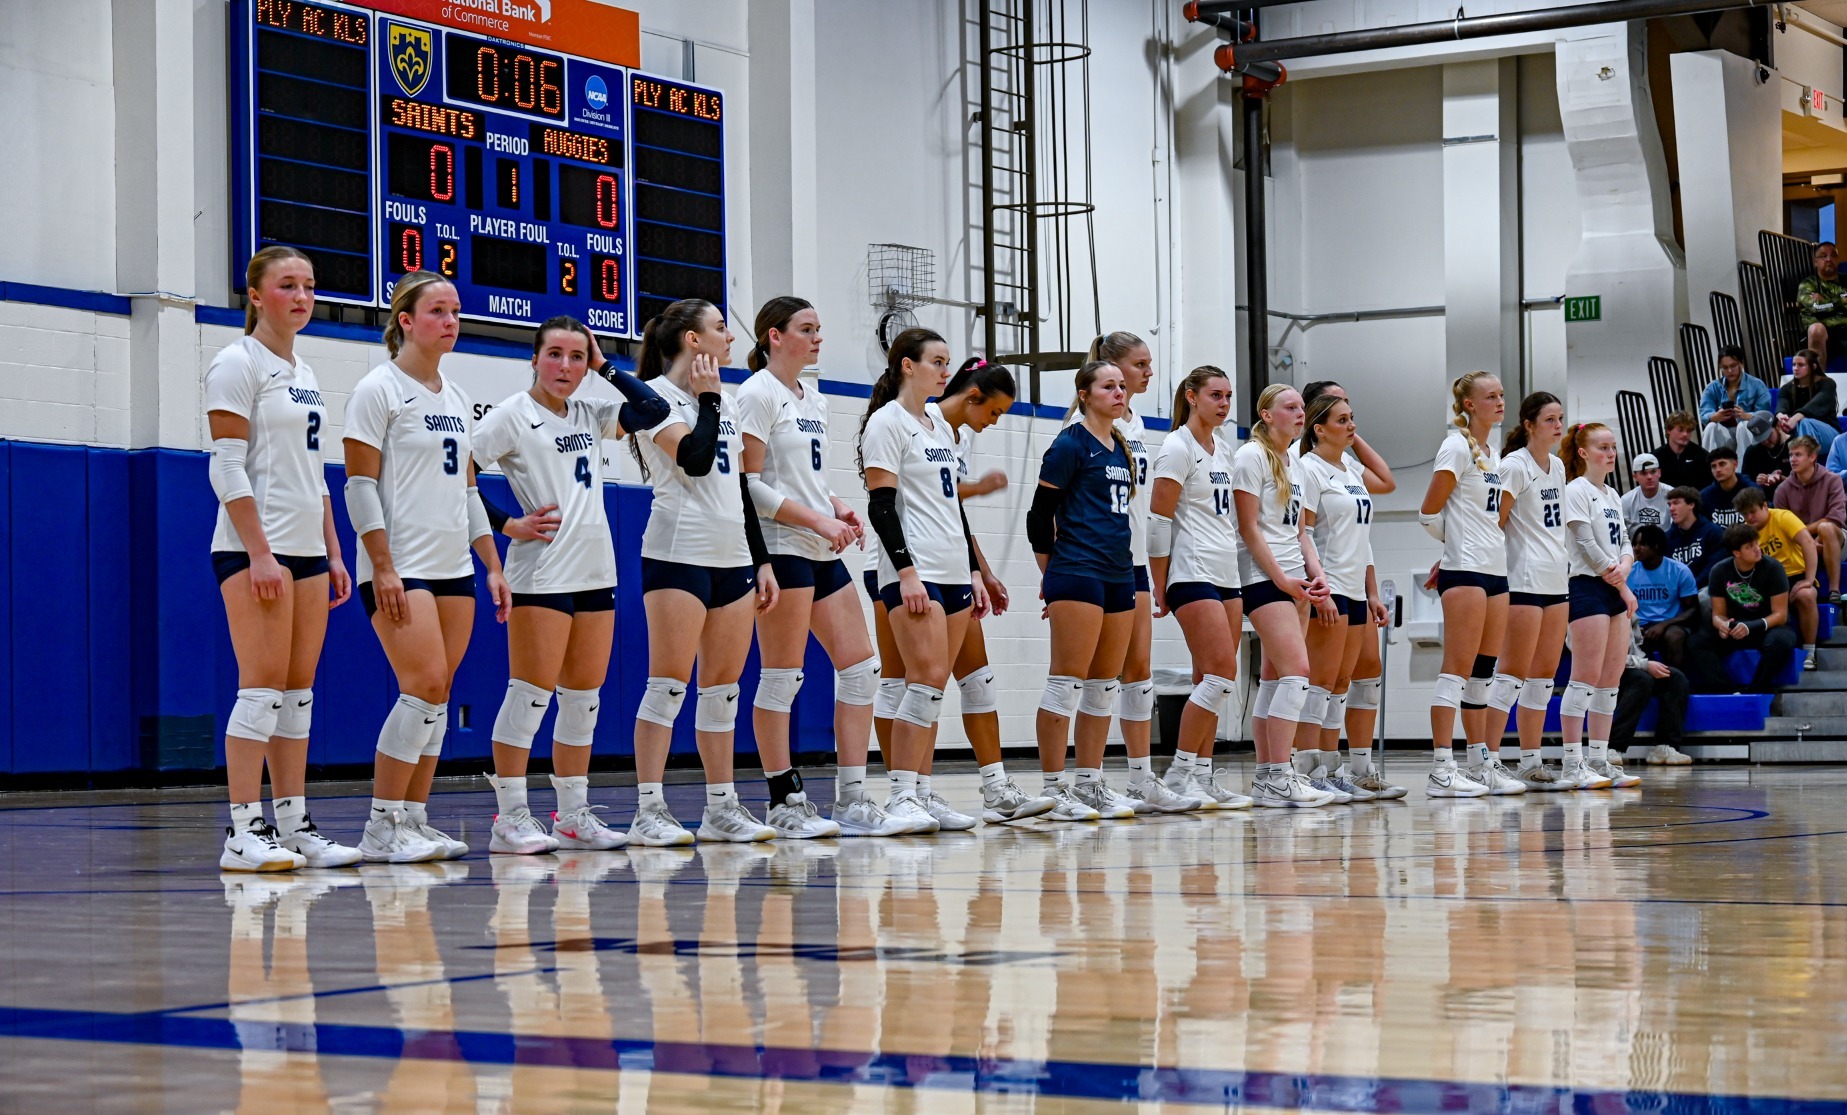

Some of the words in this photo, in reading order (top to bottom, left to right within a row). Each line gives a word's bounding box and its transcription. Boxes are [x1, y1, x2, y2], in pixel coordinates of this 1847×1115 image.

[258, 0, 291, 27] PLY
[303, 7, 325, 35] AC
[334, 13, 366, 44] KLS
[441, 6, 453, 18] of
[454, 7, 509, 31] Commerce
[503, 0, 536, 22] Bank
[487, 36, 526, 49] DAKTRONICS
[478, 46, 561, 114] 0:06
[587, 90, 608, 103] NCAA
[634, 80, 662, 107] PLY
[669, 88, 688, 113] AC
[694, 92, 721, 120] KLS
[1813, 89, 1825, 111] EXIT
[392, 99, 475, 138] SAINTS
[582, 108, 605, 122] Division
[486, 132, 529, 156] PERIOD
[544, 128, 609, 163] AUGGIES
[430, 144, 453, 200] 0
[511, 167, 518, 203] 1
[385, 200, 427, 225] FOULS
[596, 174, 618, 228] 0
[435, 223, 461, 241] T.O.L.
[470, 214, 517, 239] PLAYER
[520, 222, 550, 244] FOUL
[402, 228, 421, 272] 0
[556, 242, 580, 259] T.O.L.
[587, 233, 623, 255] FOULS
[441, 244, 456, 276] 2
[562, 262, 577, 292] 2
[602, 259, 619, 300] 0
[489, 294, 531, 318] MATCH
[587, 308, 625, 330] SCORE
[1569, 298, 1597, 319] EXIT
[306, 411, 321, 451] 2
[424, 414, 465, 433] SAINTS
[796, 417, 824, 434] SAINTS
[554, 432, 593, 453] SAINTS
[810, 438, 822, 471] 6
[924, 447, 955, 463] SAINTS
[442, 437, 459, 475] 3
[714, 440, 731, 474] 5
[574, 455, 592, 490] 4
[940, 467, 954, 498] 8
[1105, 464, 1131, 483] SAINTS
[1209, 471, 1231, 485] SAINTS
[1109, 483, 1129, 515] 12
[1213, 488, 1230, 515] 14
[1356, 498, 1371, 525] 17
[1544, 502, 1562, 528] 22
[1711, 511, 1746, 526] SAINTS
[1632, 587, 1670, 601] SAINTS
